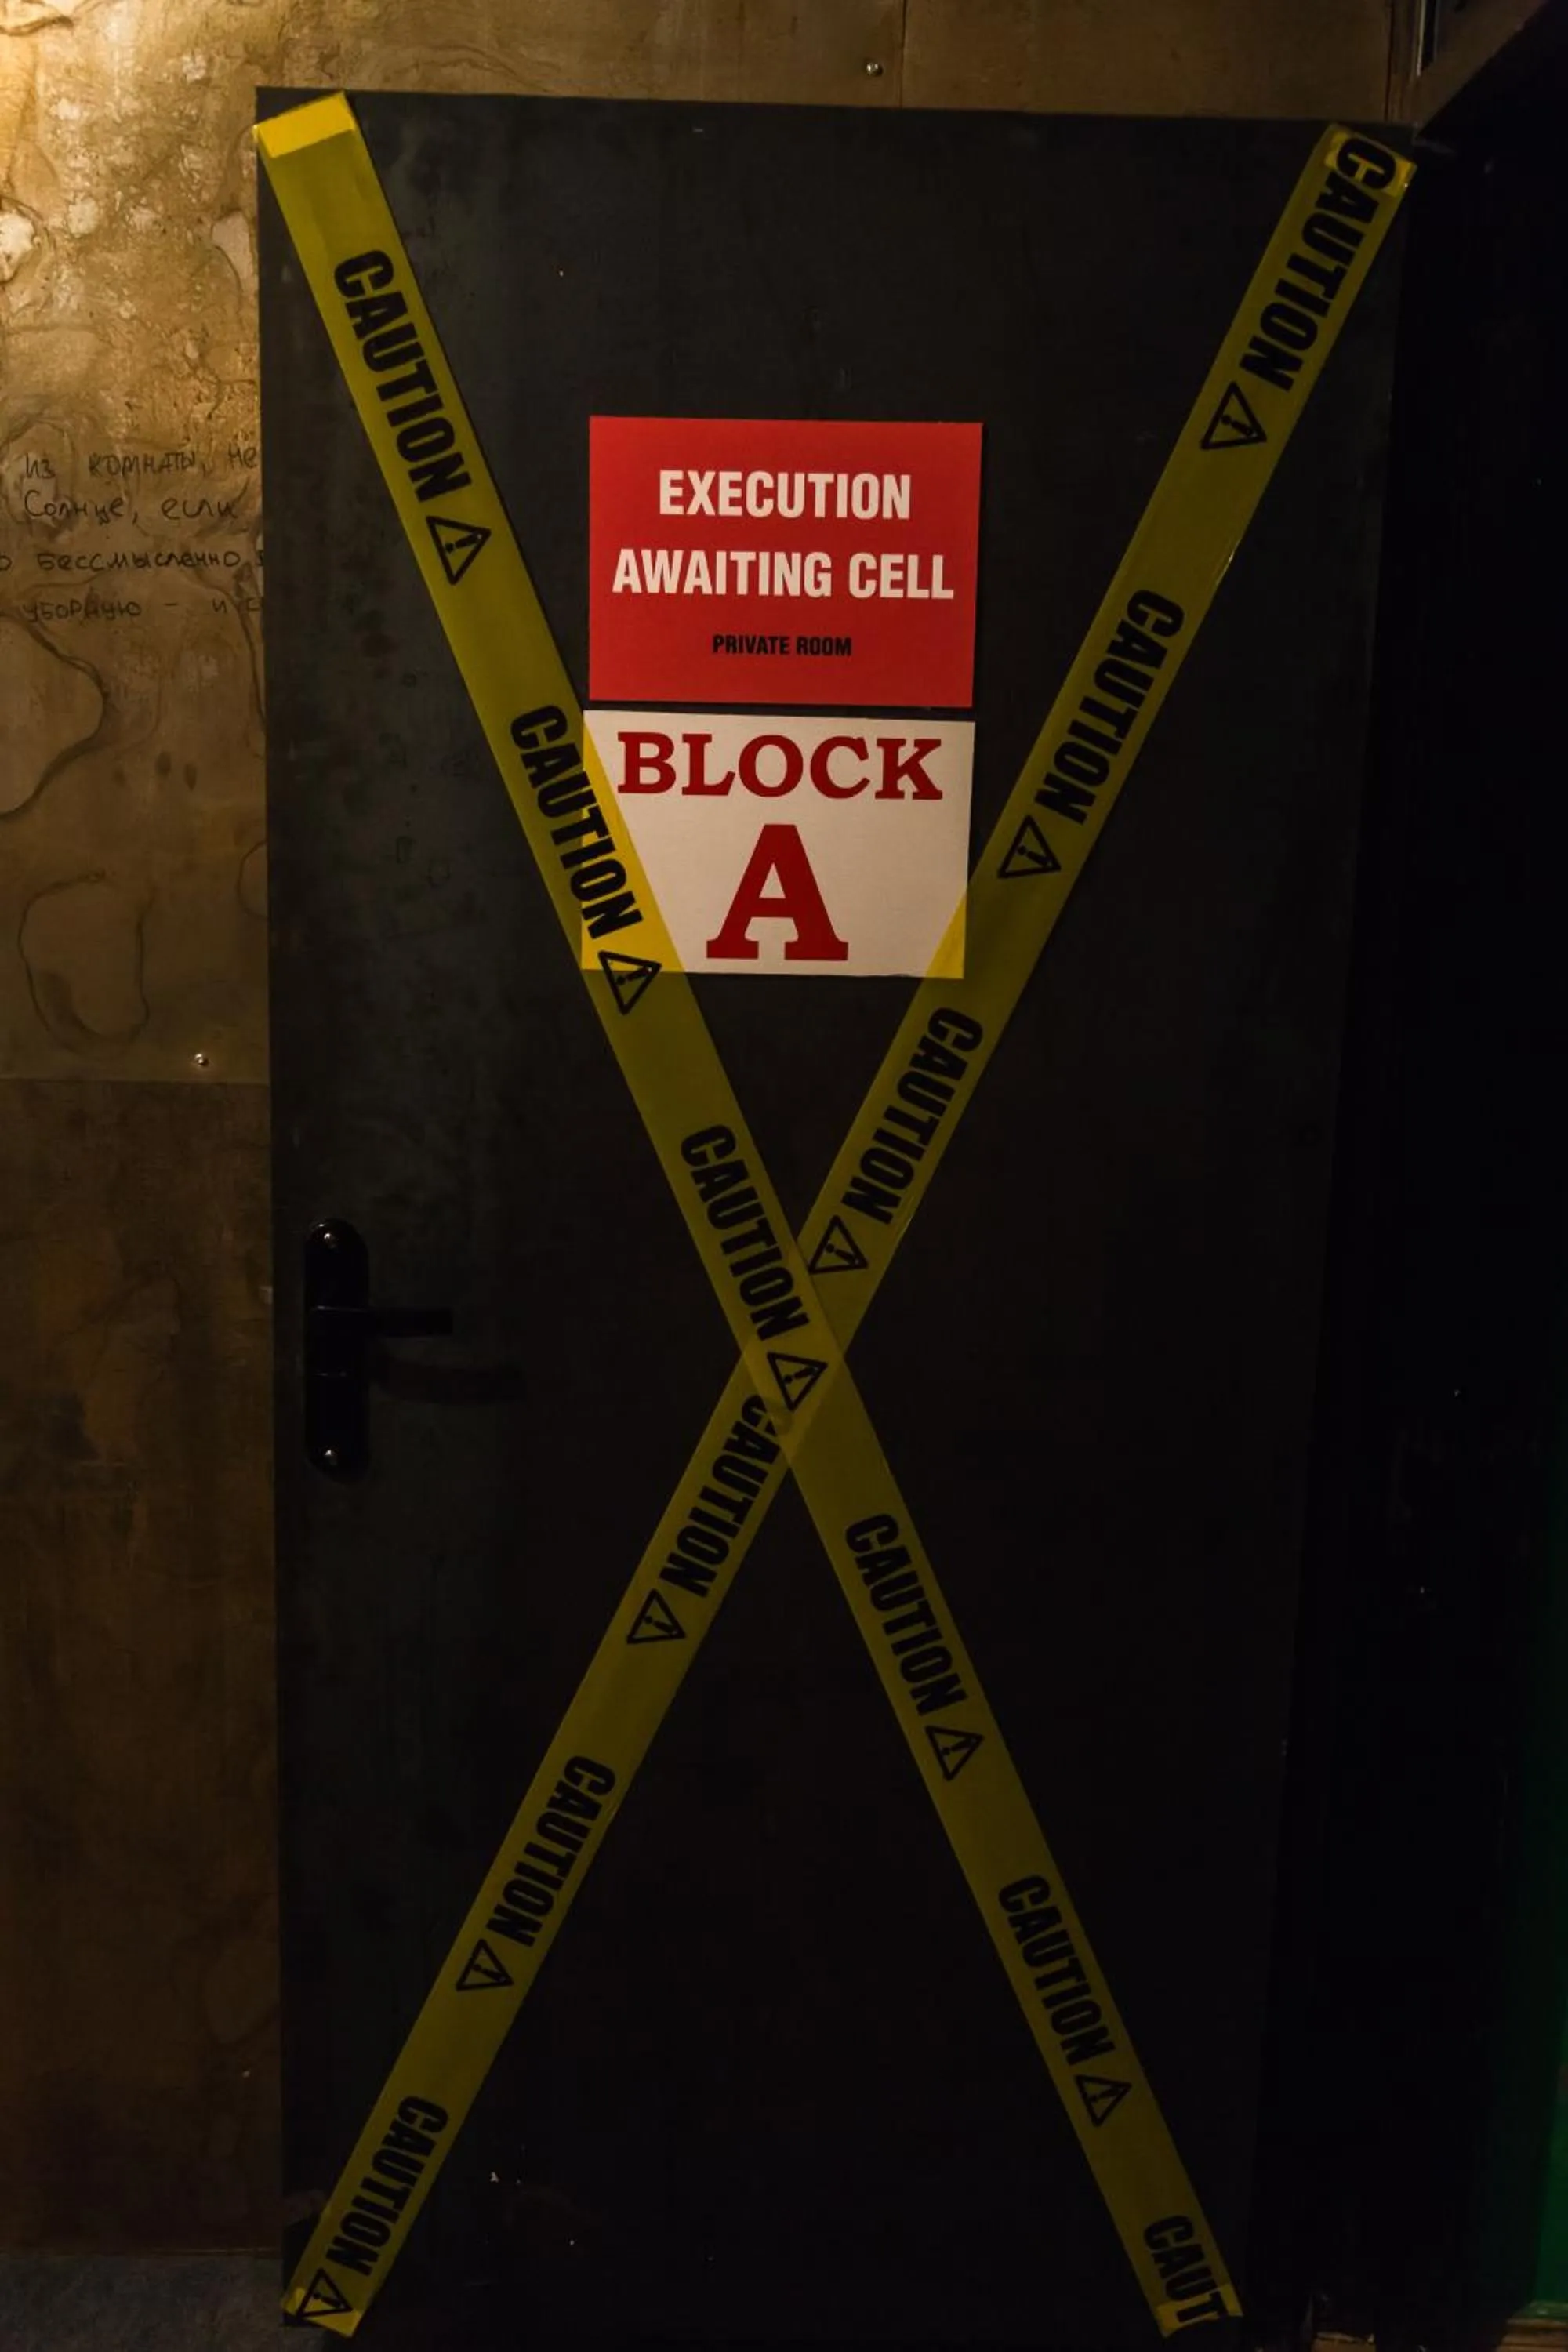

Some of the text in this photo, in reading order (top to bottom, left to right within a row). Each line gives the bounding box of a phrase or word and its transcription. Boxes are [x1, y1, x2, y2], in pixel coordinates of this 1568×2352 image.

[1240, 138, 1396, 391] CAUTION
[612, 548, 954, 600] AWAITING CELL
[659, 470, 911, 520] EXECUTION
[713, 635, 852, 657] PRIVATE ROOM
[1035, 590, 1185, 826] CAUTION
[618, 732, 942, 800] BLOCK
[706, 824, 849, 961] A
[335, 250, 471, 502] CAUTION
[511, 706, 643, 939] CAUTION
[681, 1125, 809, 1341] CAUTION
[846, 1514, 968, 1715] CAUTION
[999, 1875, 1116, 2066] CAUTION
[841, 1007, 982, 1225] CAUTION
[486, 1756, 615, 1947] CAUTION
[326, 2096, 448, 2276] CAUTION
